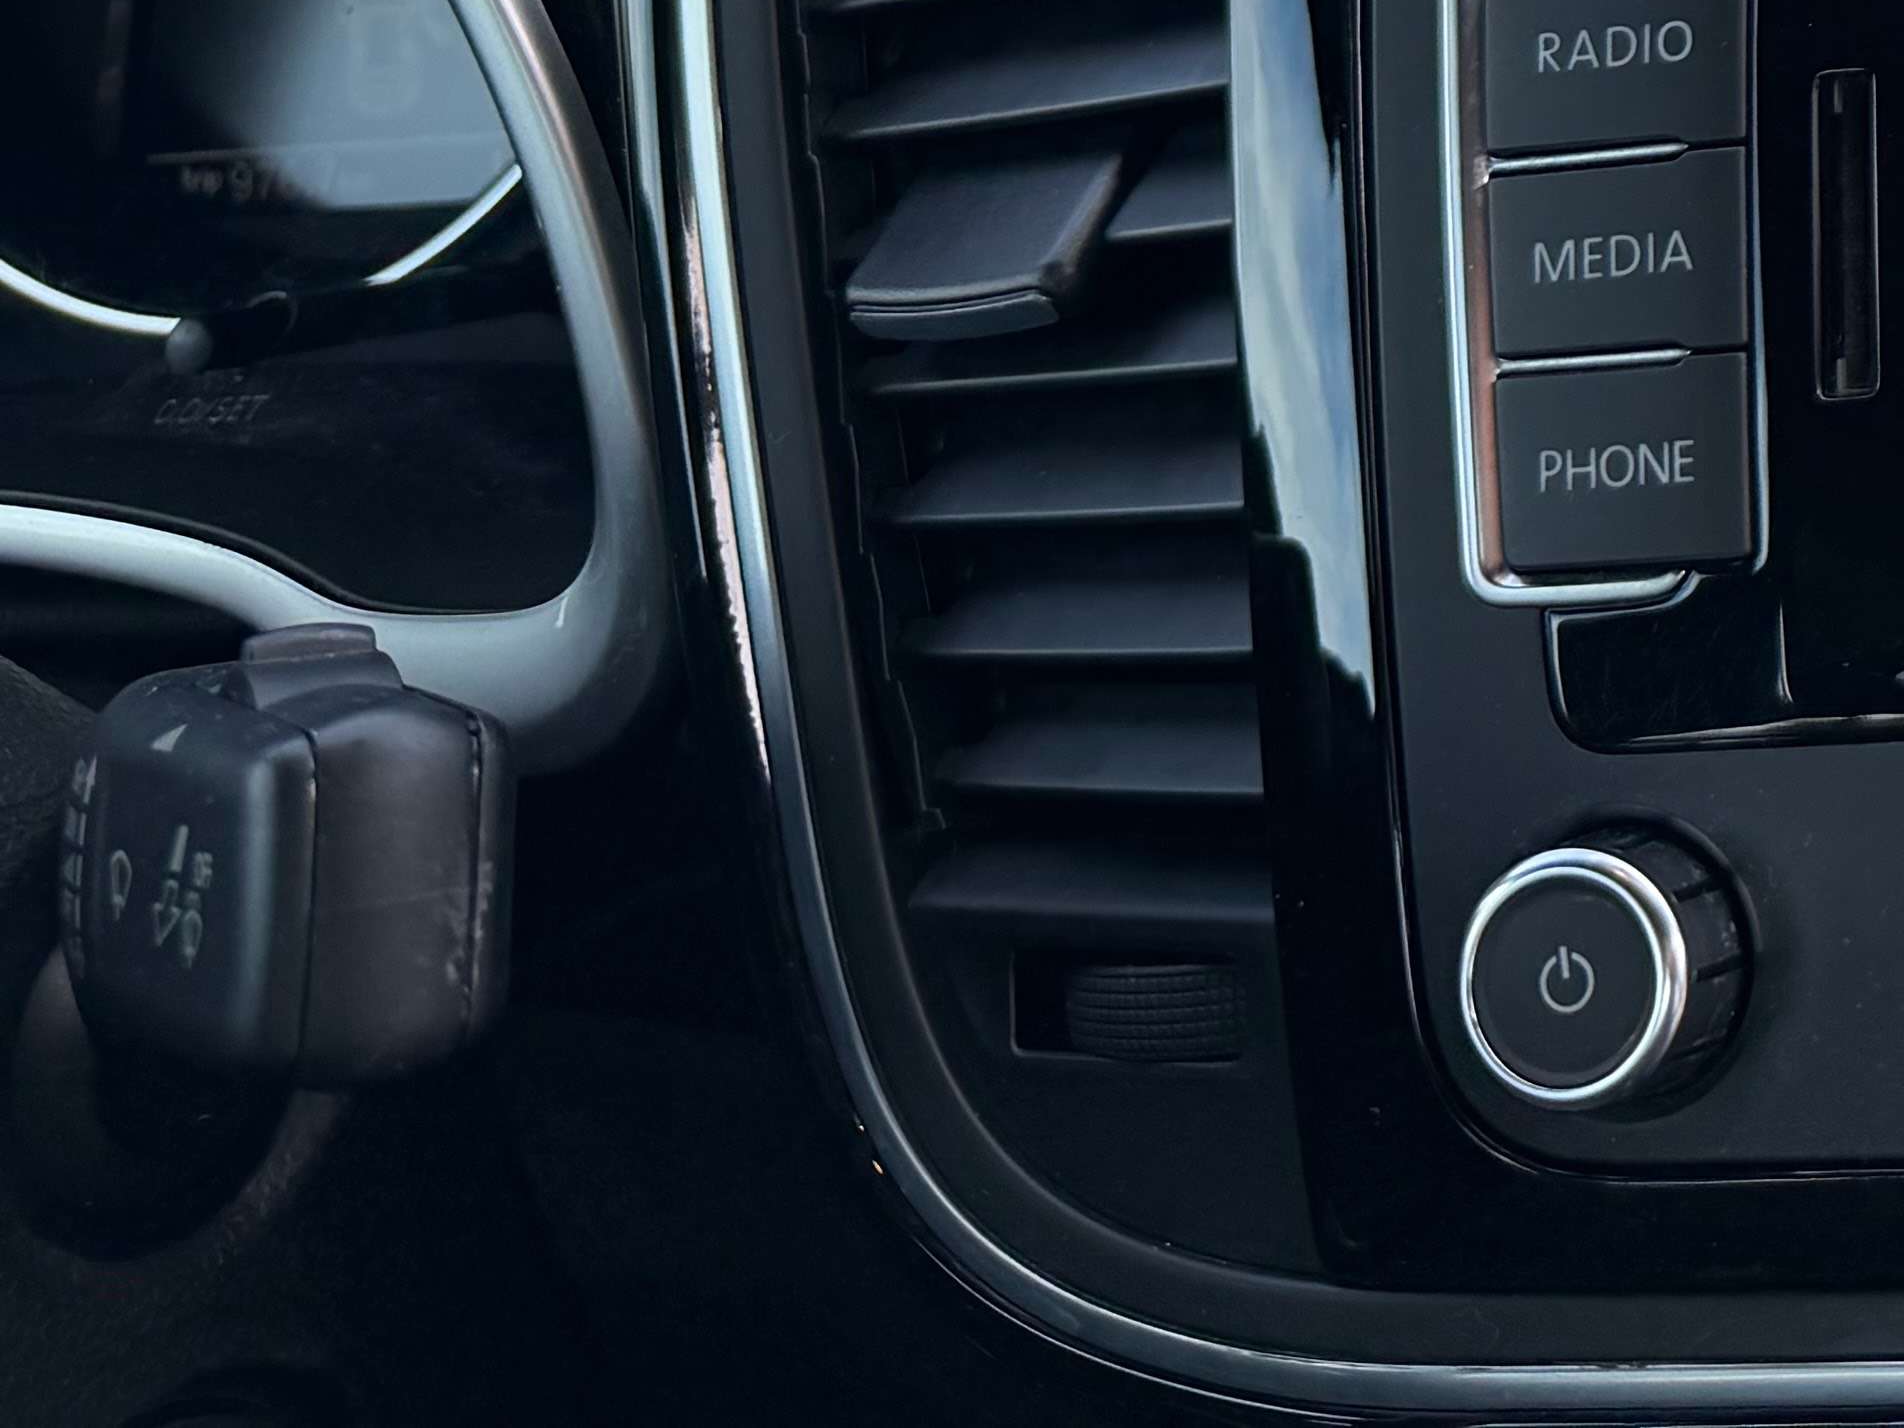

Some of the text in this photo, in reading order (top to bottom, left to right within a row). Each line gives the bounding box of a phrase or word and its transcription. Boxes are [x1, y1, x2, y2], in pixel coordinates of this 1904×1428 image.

[1537, 20, 1694, 72] RADIO
[1533, 231, 1693, 284] MEDIA
[1539, 439, 1695, 492] PHONE
